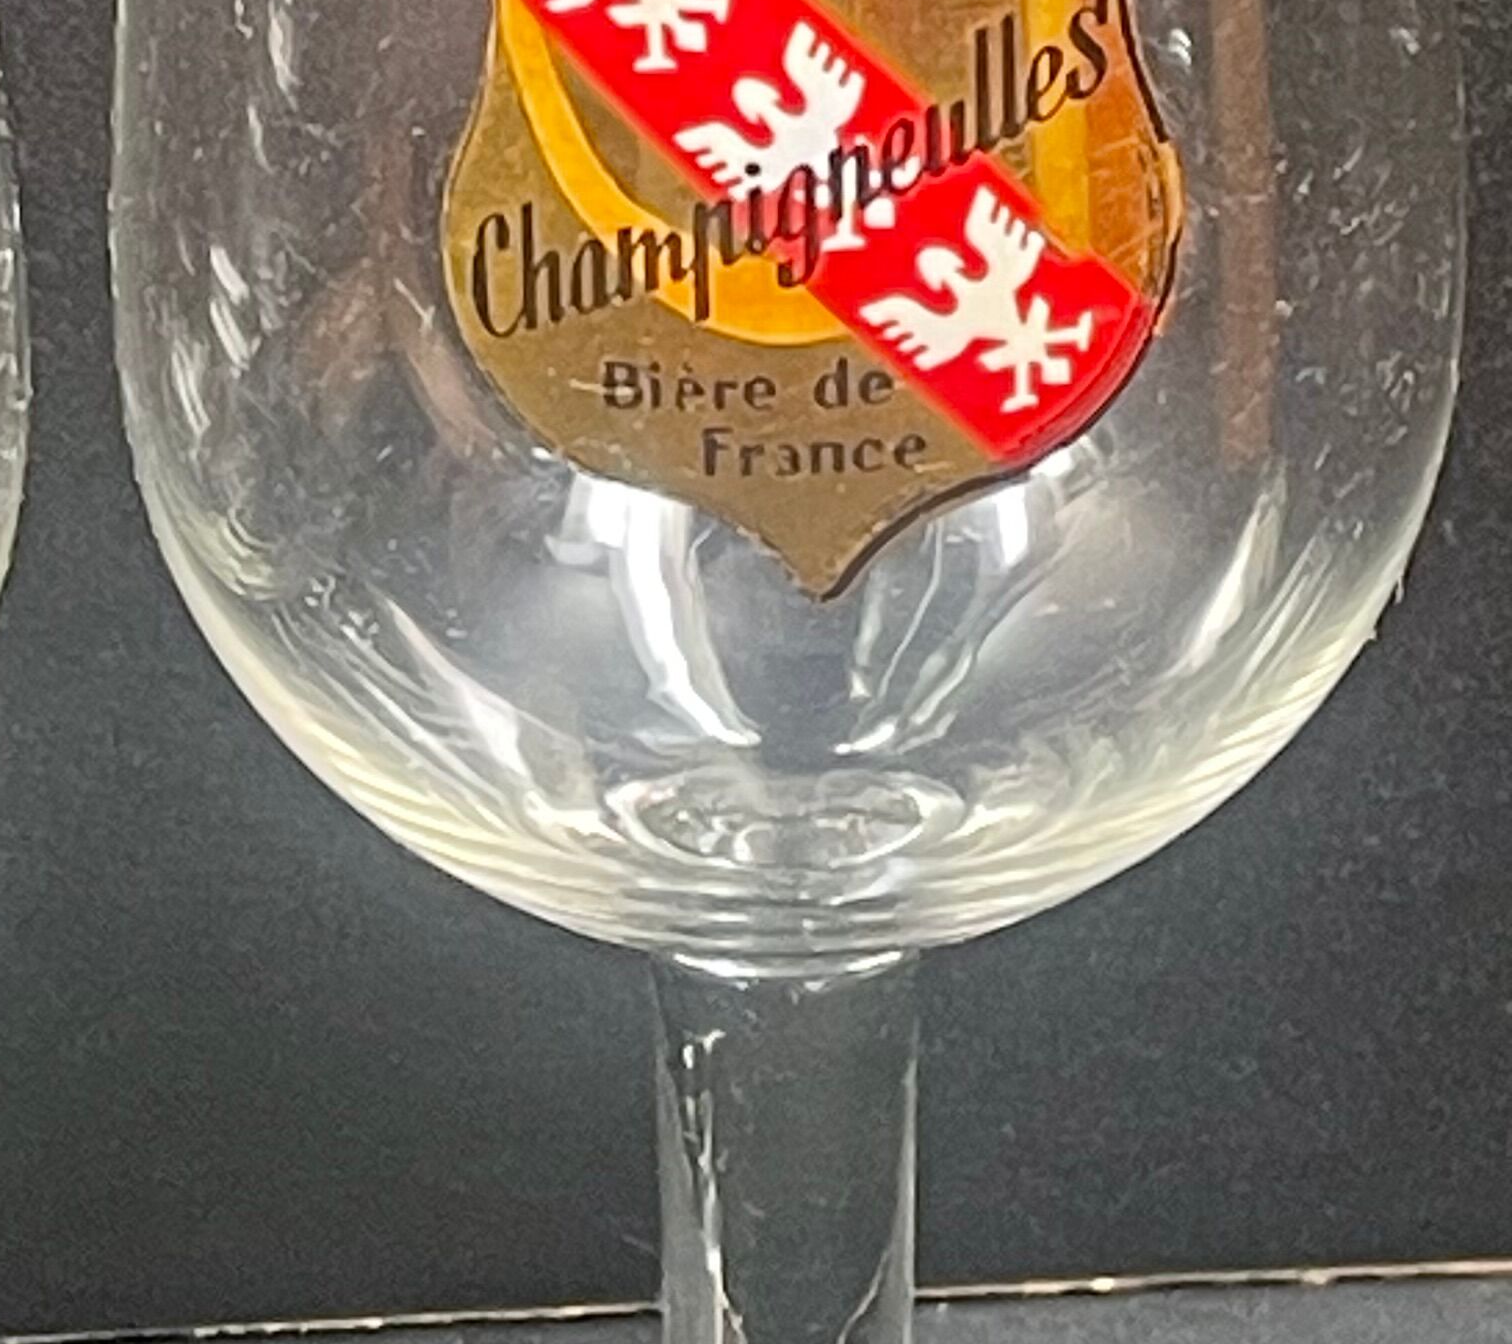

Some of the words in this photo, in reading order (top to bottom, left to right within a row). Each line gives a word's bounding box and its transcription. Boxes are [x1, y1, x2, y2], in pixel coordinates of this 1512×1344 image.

[603, 358, 778, 411] Bière
[814, 358, 895, 408] de
[703, 425, 928, 476] France
